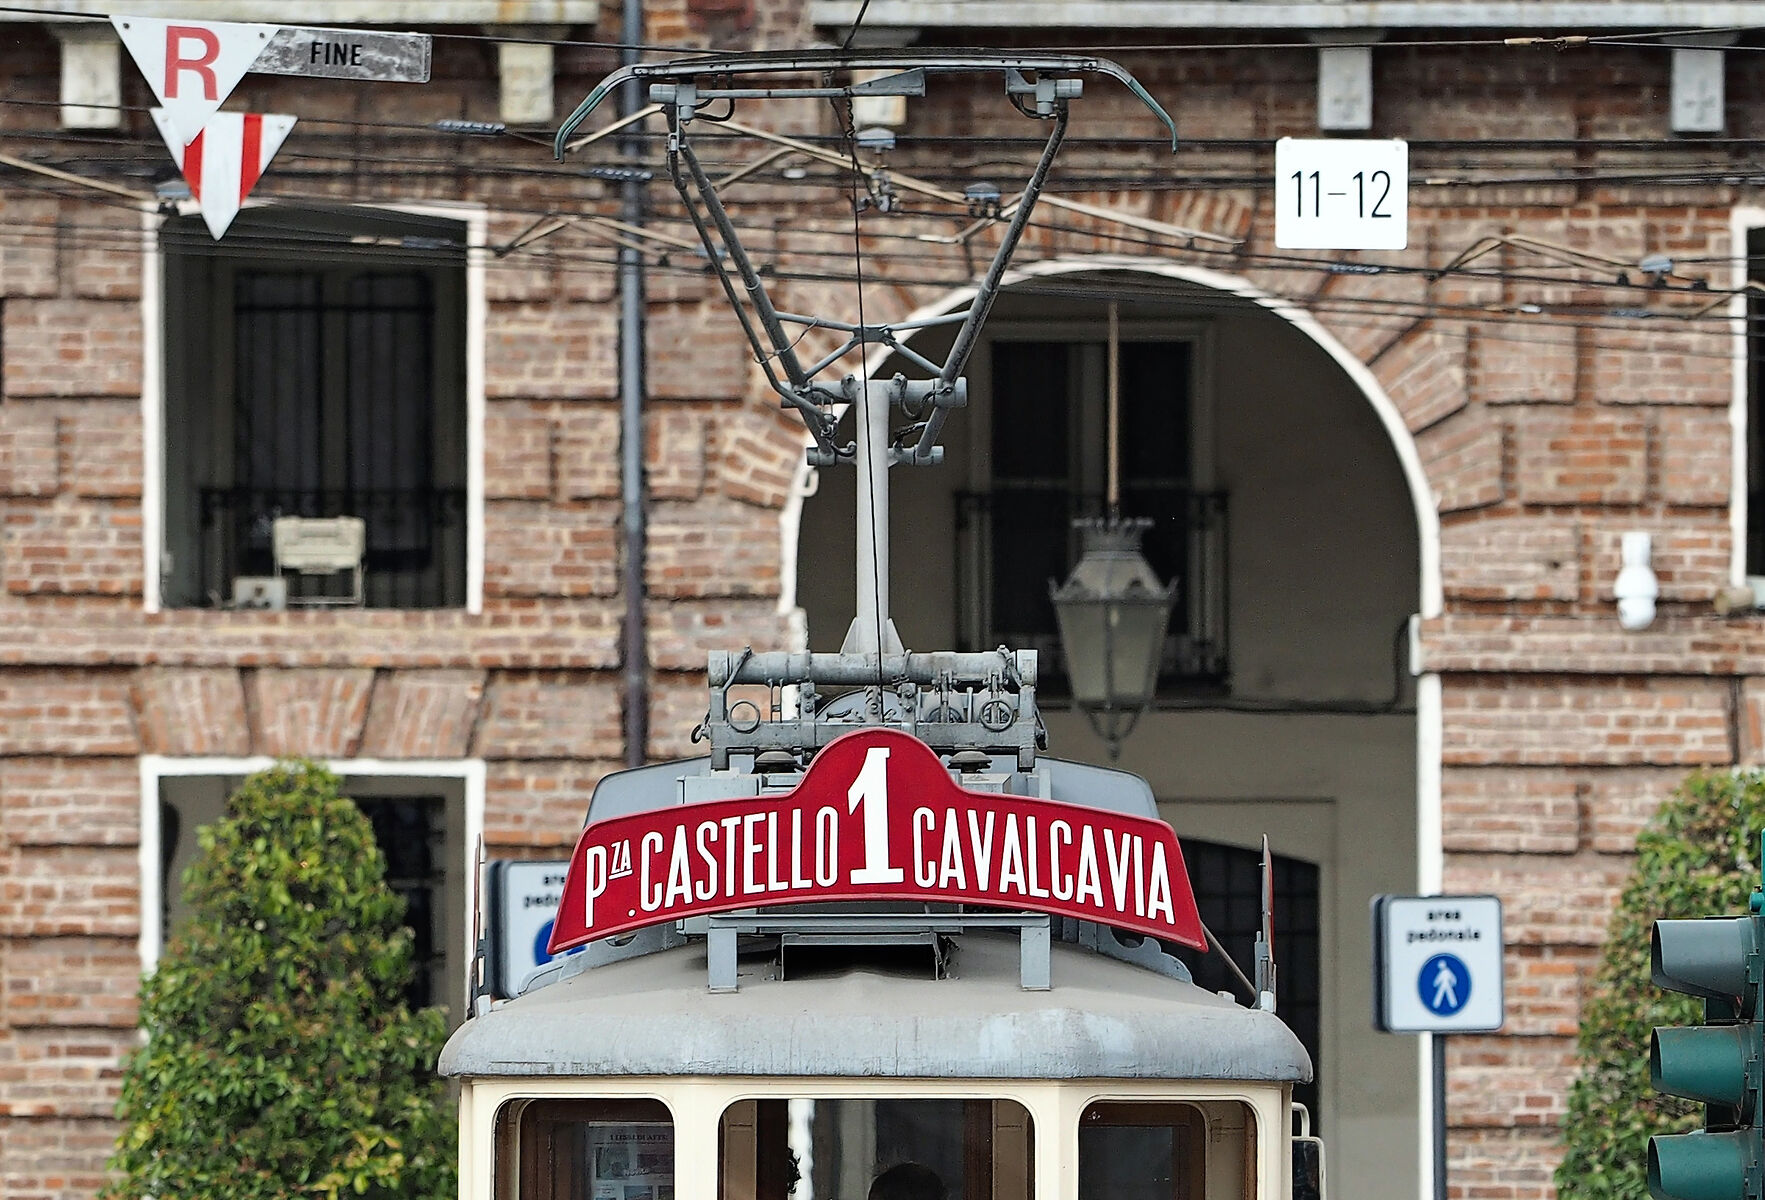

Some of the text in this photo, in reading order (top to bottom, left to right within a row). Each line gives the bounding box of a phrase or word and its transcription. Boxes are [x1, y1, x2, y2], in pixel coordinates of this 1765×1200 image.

[164, 25, 219, 100] R
[311, 42, 363, 66] FINE
[1291, 170, 1392, 218] 11-12
[640, 806, 839, 912] CASTELLO
[847, 747, 904, 885] 1
[913, 806, 1176, 925] CAVALCAVIA
[1428, 911, 1461, 921] area
[1407, 927, 1480, 944] pedonale
